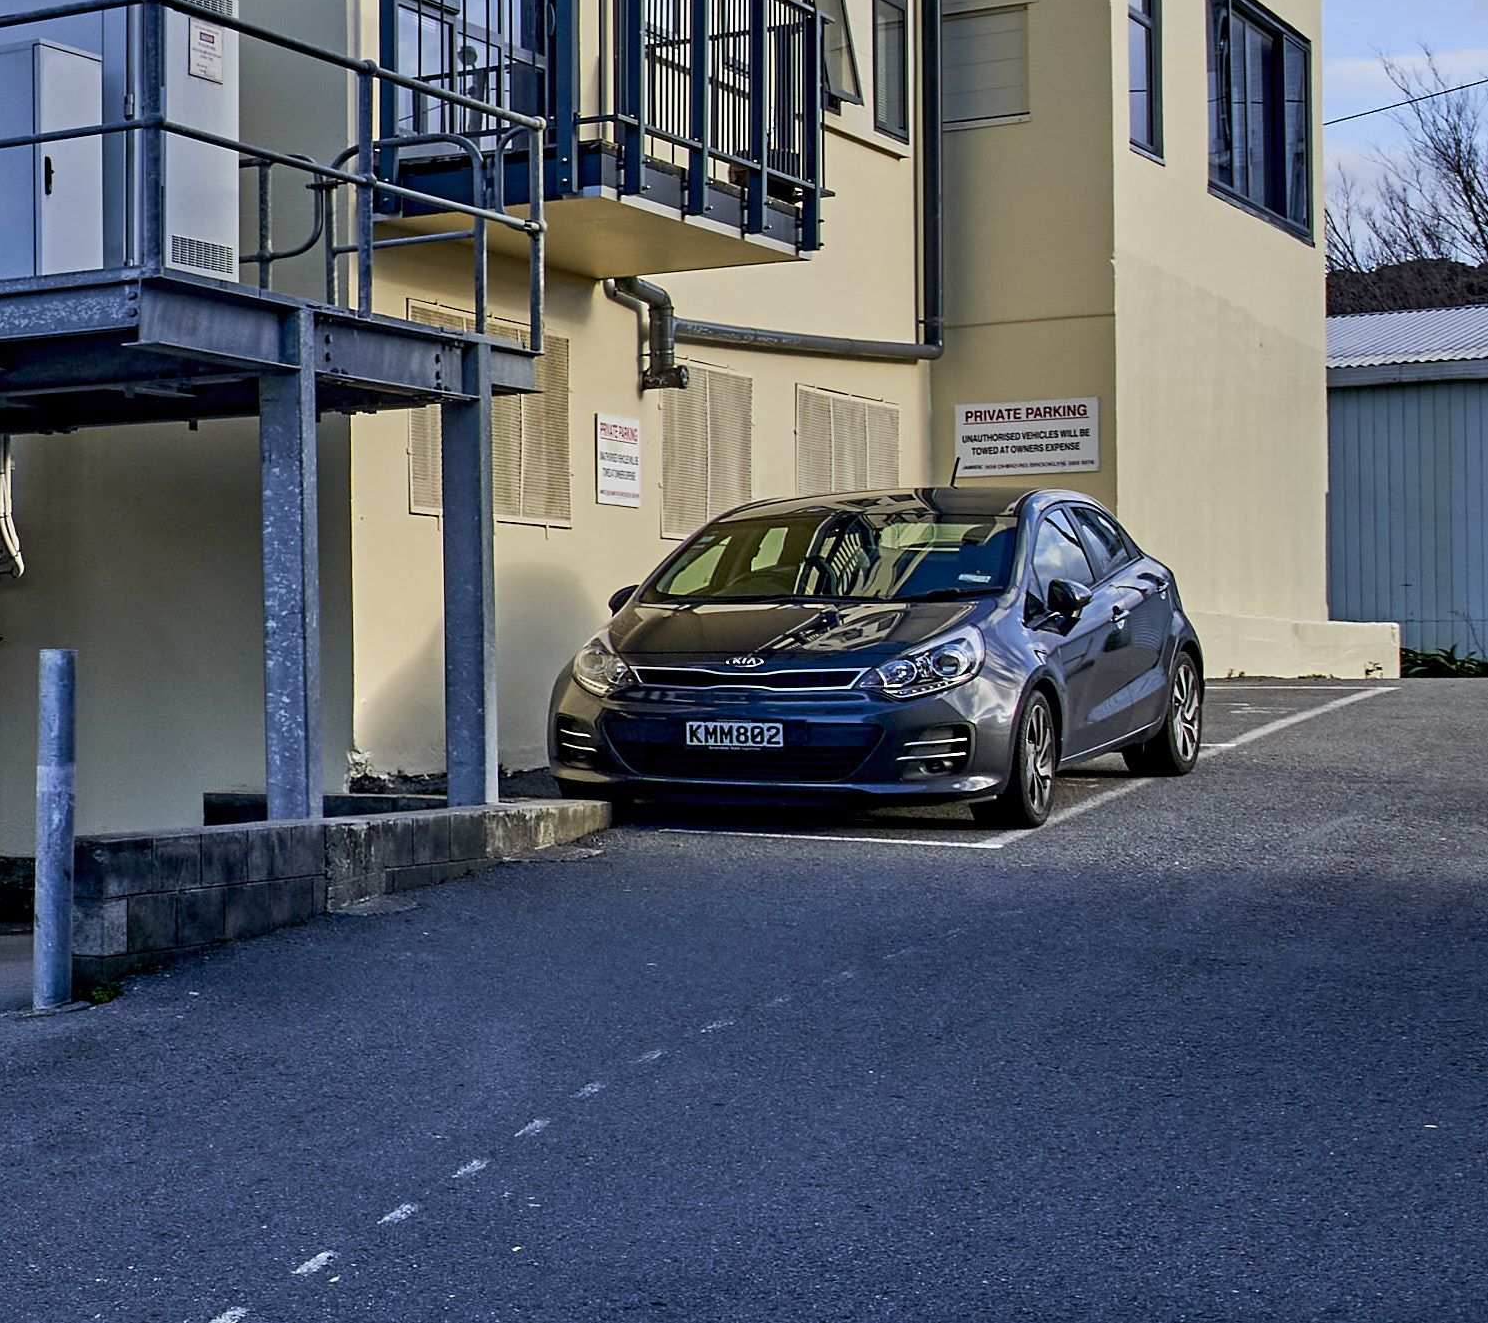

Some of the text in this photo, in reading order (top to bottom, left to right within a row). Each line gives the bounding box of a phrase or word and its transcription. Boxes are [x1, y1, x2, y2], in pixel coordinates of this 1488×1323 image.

[965, 404, 1087, 422] PRIVATE PARKING
[962, 428, 1090, 443] UNAUTHORISED VEHICLES WILL BE
[972, 442, 1080, 455] TOWED AT OWNERS EXPENSE
[688, 724, 781, 746] KMM802
